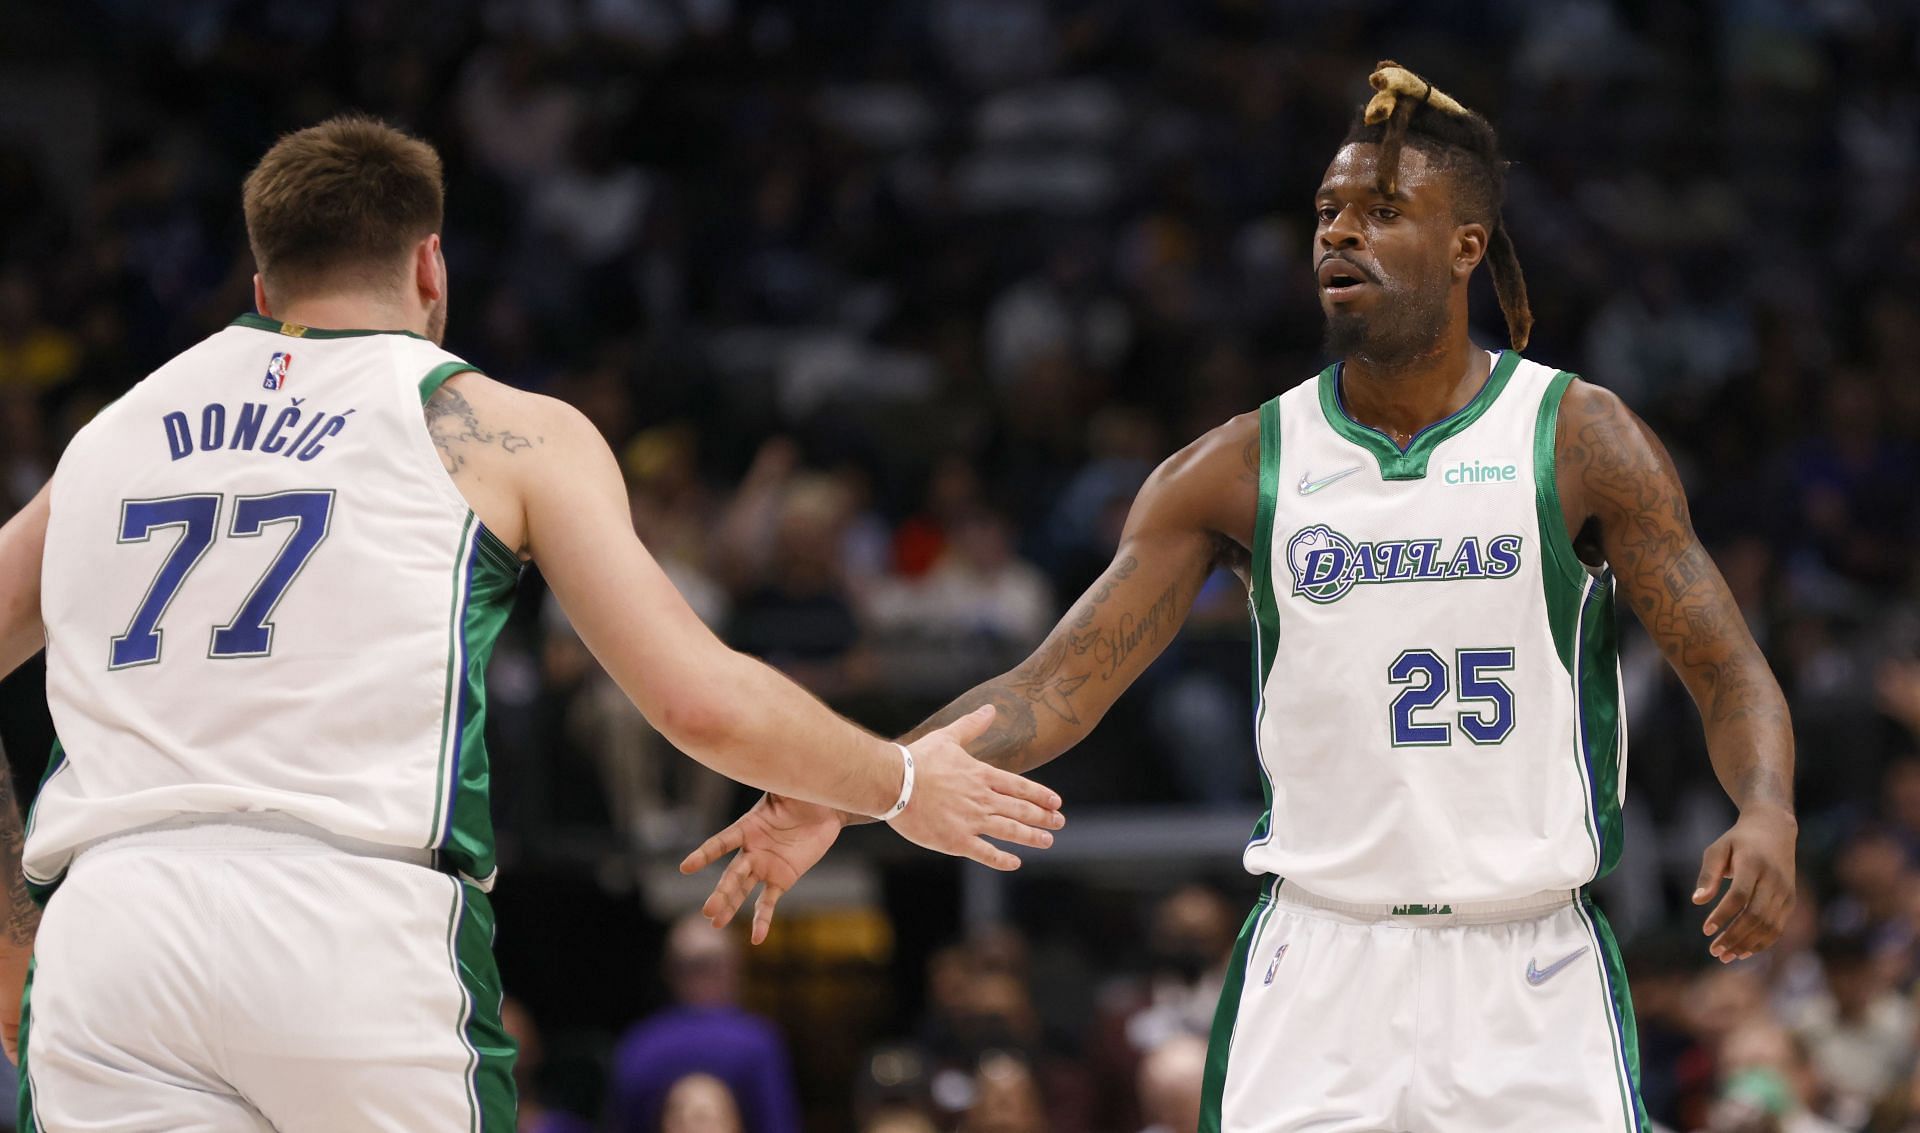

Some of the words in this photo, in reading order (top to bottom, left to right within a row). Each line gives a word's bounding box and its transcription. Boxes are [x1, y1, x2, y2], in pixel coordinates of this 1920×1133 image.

[162, 397, 357, 462] DONČIĆ
[1444, 460, 1517, 486] chime
[107, 488, 337, 672] 77
[1094, 580, 1180, 682] Hungry
[1388, 646, 1517, 748] 25
